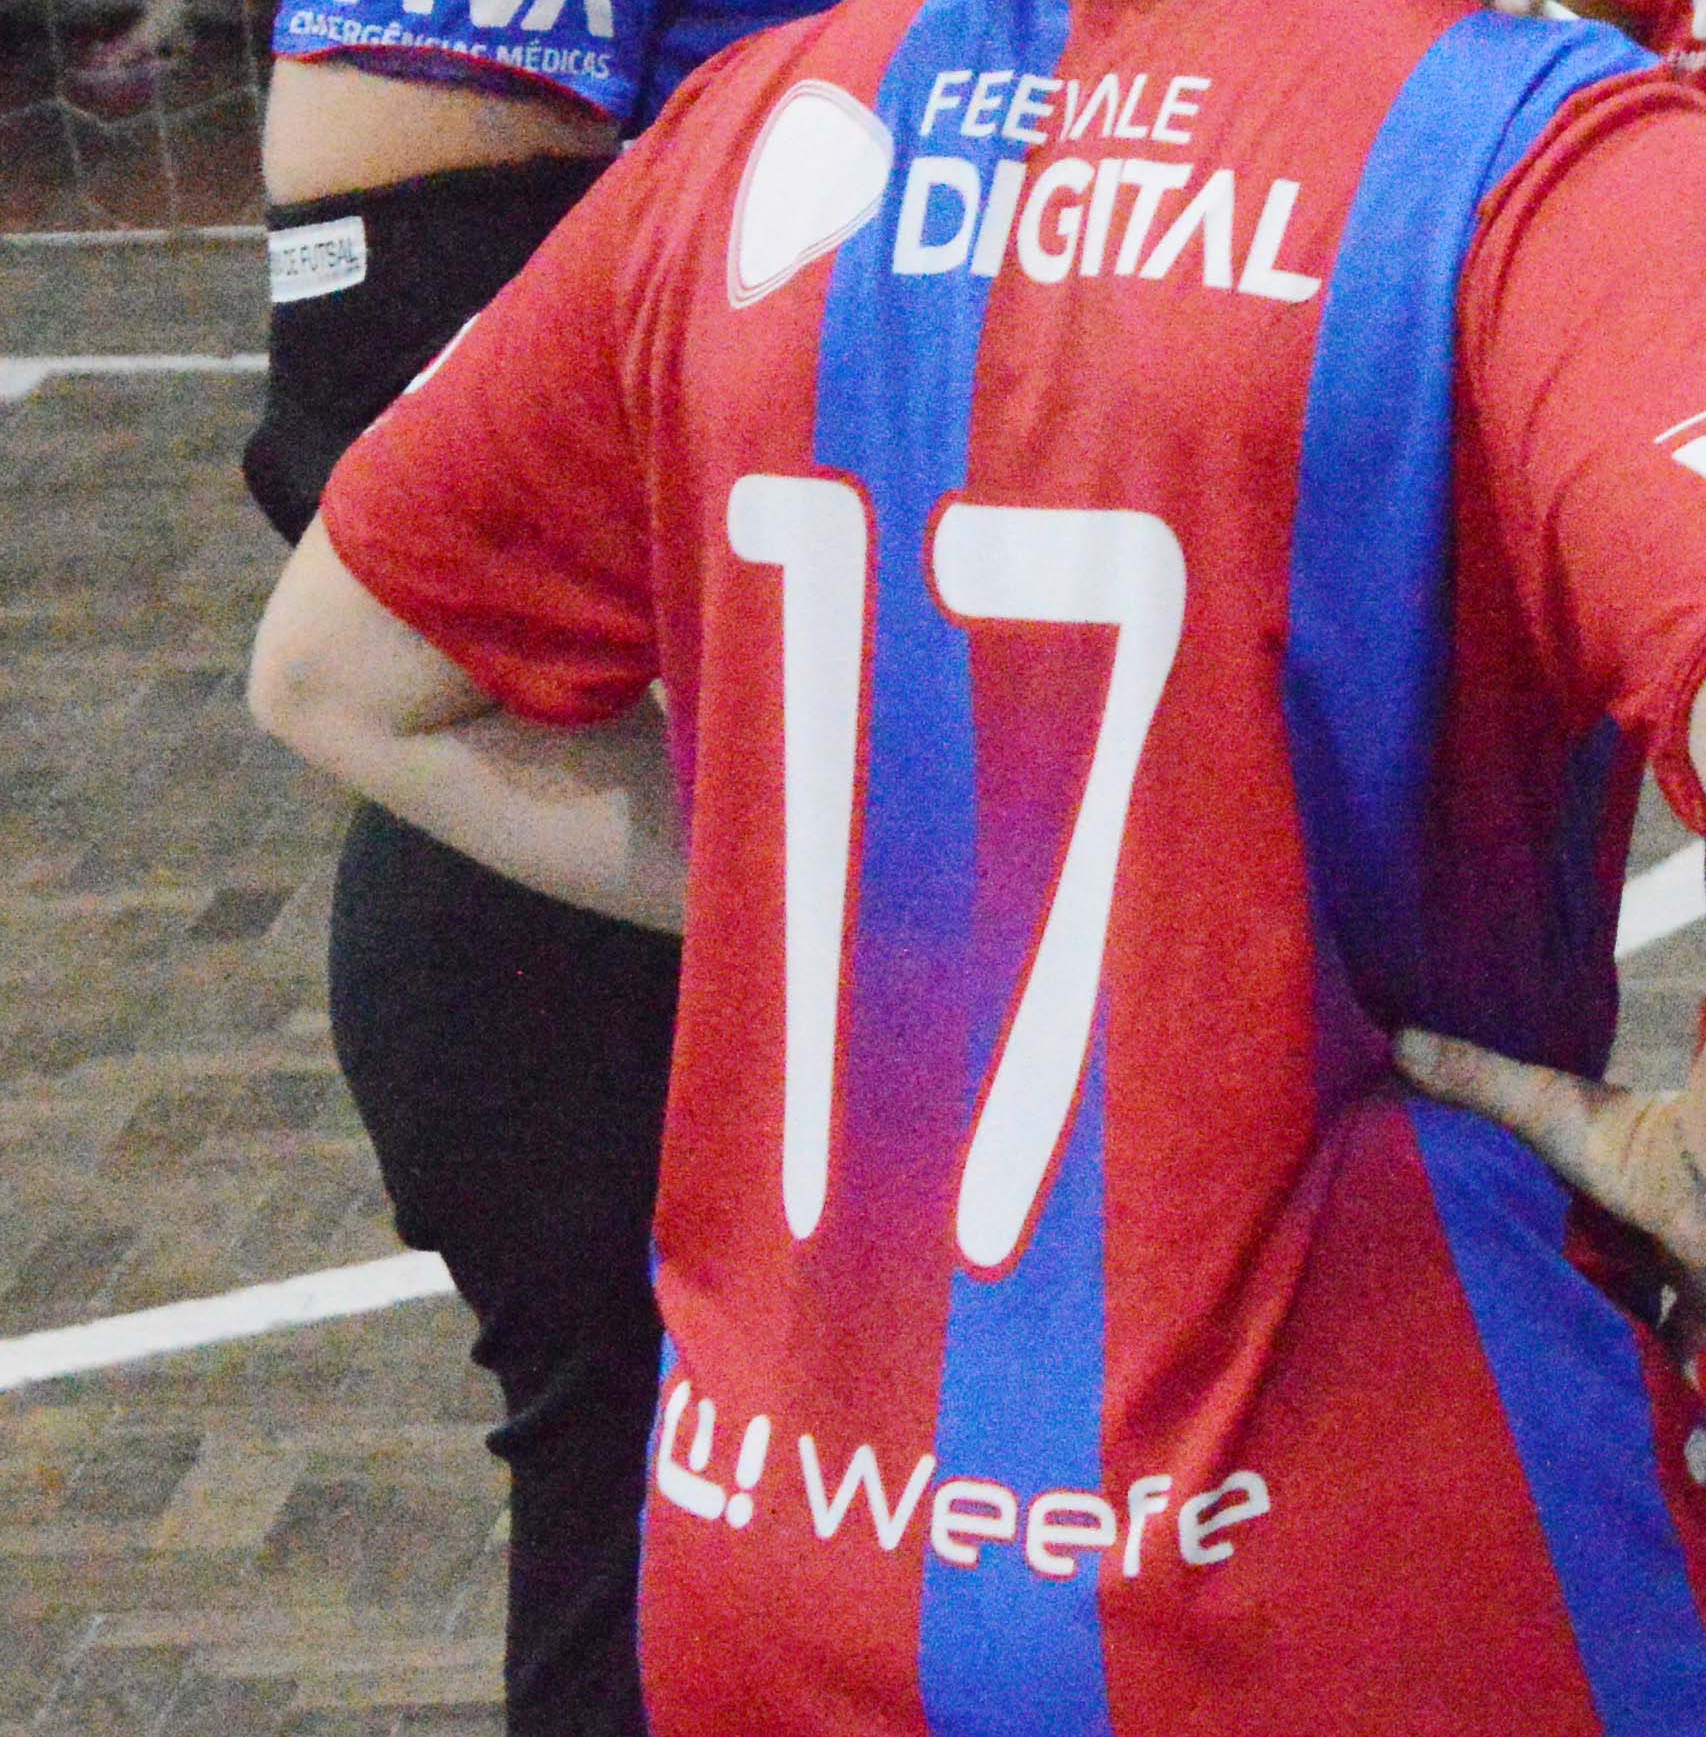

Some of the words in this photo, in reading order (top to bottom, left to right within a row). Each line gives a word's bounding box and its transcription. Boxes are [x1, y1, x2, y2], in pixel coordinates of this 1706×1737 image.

[495, 38, 613, 80] MÉDICAS
[918, 68, 1212, 145] FEEVALE
[892, 155, 1323, 303] DIGITAL
[726, 473, 1188, 1268] 17
[798, 1433, 1272, 1578] Weefe
